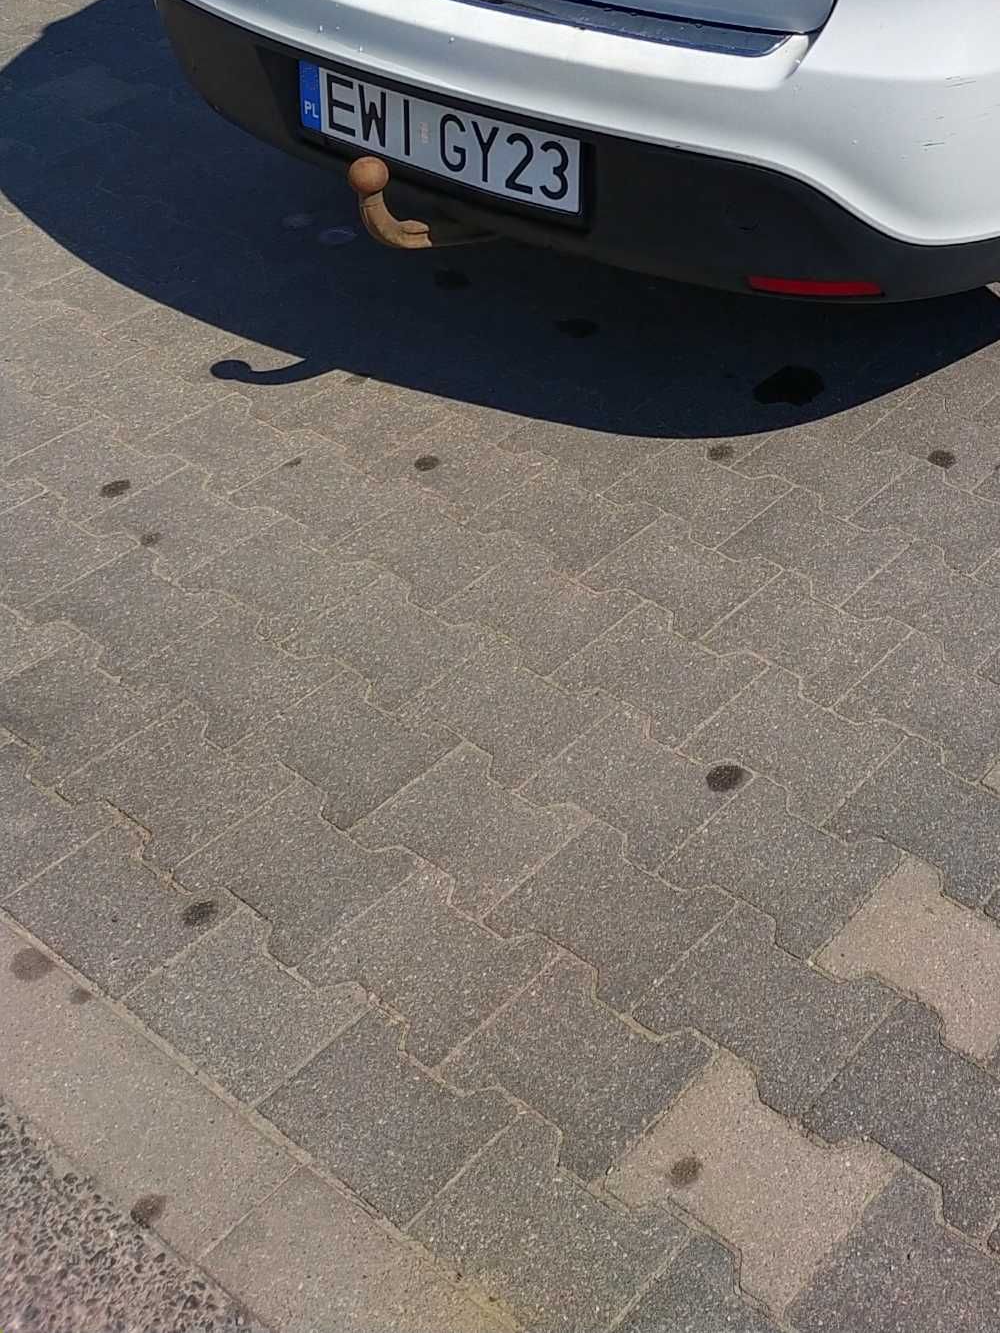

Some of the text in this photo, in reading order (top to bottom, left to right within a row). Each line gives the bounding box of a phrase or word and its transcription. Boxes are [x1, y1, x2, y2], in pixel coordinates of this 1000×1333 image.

[304, 101, 320, 119] PL
[325, 71, 569, 201] EWI GY23
